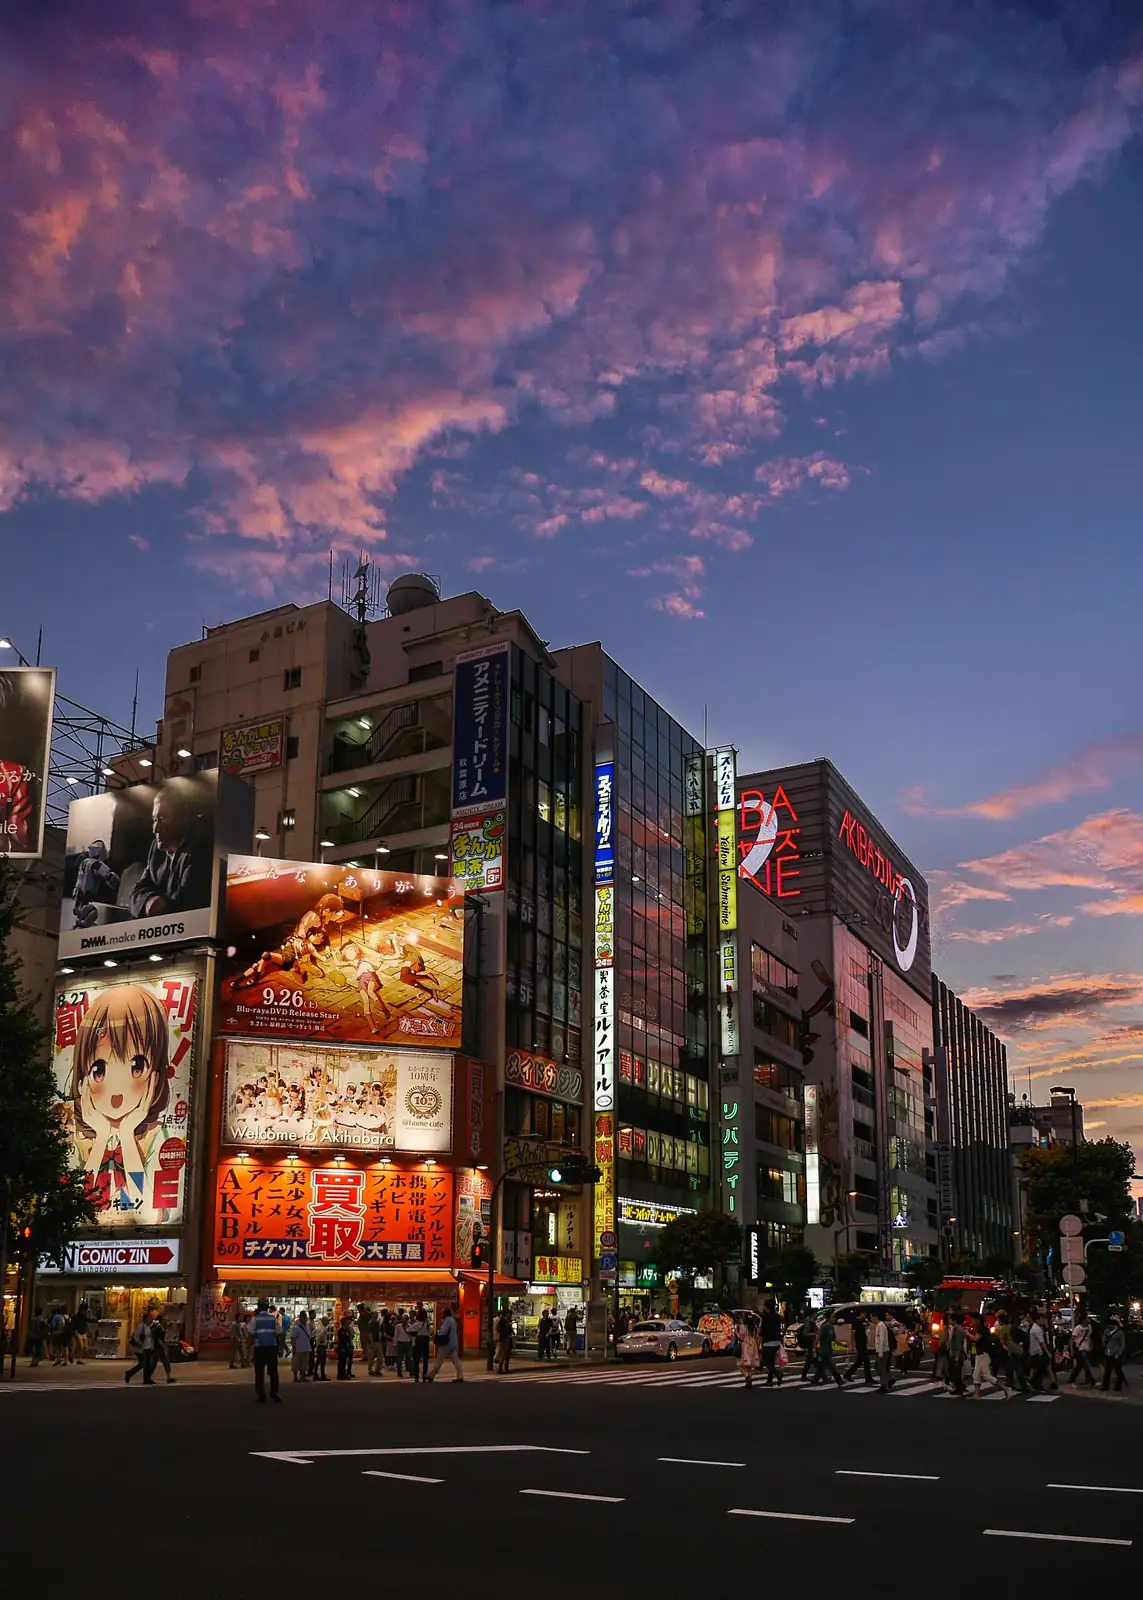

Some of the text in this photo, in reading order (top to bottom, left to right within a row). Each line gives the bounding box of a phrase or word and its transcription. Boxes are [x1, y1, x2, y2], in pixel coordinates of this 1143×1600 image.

[471, 661, 489, 797] アメニティードリーム
[459, 758, 468, 801] 秋葉原店
[456, 801, 505, 816] AMENITY DREAM
[453, 834, 501, 859] まんが
[721, 836, 730, 867] Yellow
[453, 859, 483, 877] 喫茶
[598, 888, 611, 925] まんが
[721, 874, 731, 927] Submarine
[138, 923, 184, 941] ROBOTS
[57, 991, 88, 1008] 8.27
[520, 984, 534, 1005] 5F
[289, 1010, 318, 1020] Release
[320, 1012, 340, 1020] Start
[410, 1073, 438, 1082] 10周年
[506, 1052, 583, 1098] メイドカジノ
[230, 1127, 396, 1148] Welcome to Akihabara
[402, 1119, 428, 1127] @home
[596, 1115, 613, 1163] 免税
[723, 1103, 739, 1212] リバティー
[267, 1170, 286, 1218] アニメ
[390, 1175, 406, 1221] ホビー
[605, 1167, 613, 1194] TAX
[244, 1169, 265, 1235] アイドル
[285, 1170, 306, 1239] 美少女系
[308, 1170, 367, 1261] 買取
[369, 1175, 387, 1240] フィギュア
[408, 1174, 427, 1240] 携帯電話
[427, 1176, 447, 1262] アップルとか
[244, 1240, 304, 1258] チケット
[565, 1211, 575, 1250] ルノアール
[79, 1248, 150, 1264] COMIC ZIN
[367, 1242, 422, 1260] 大黒屋
[604, 1257, 612, 1269] P
[751, 1231, 759, 1280] GALLERIA
